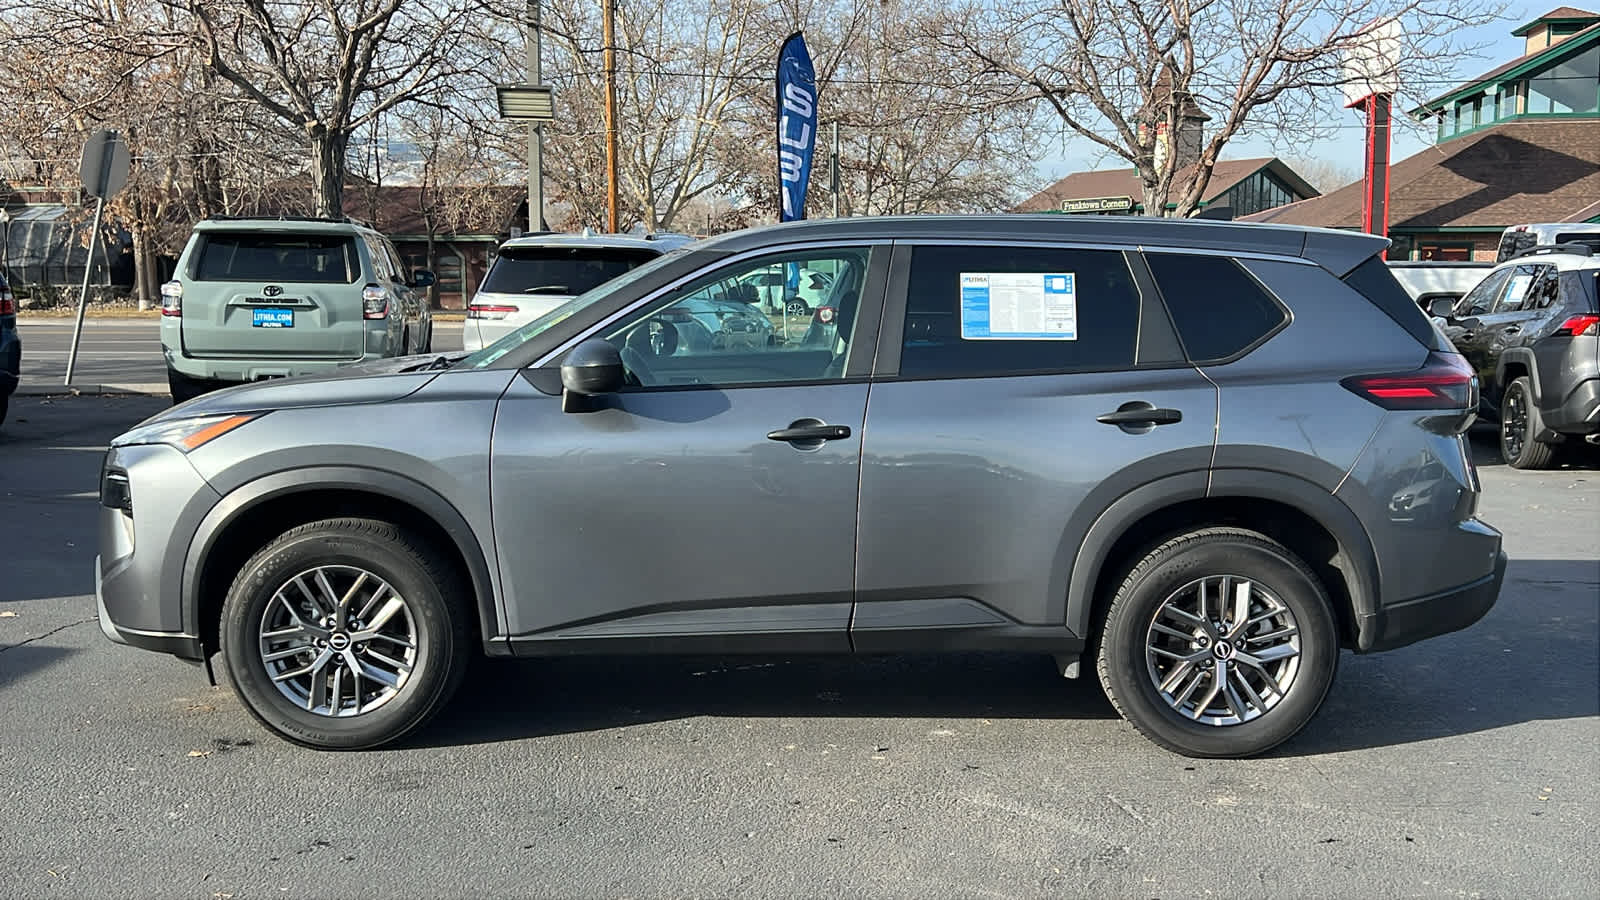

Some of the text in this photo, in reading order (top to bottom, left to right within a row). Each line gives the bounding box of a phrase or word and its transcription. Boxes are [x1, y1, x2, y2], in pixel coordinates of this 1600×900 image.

[1064, 200, 1128, 210] Franktown Corners
[254, 313, 292, 321] LITHIA.COM
